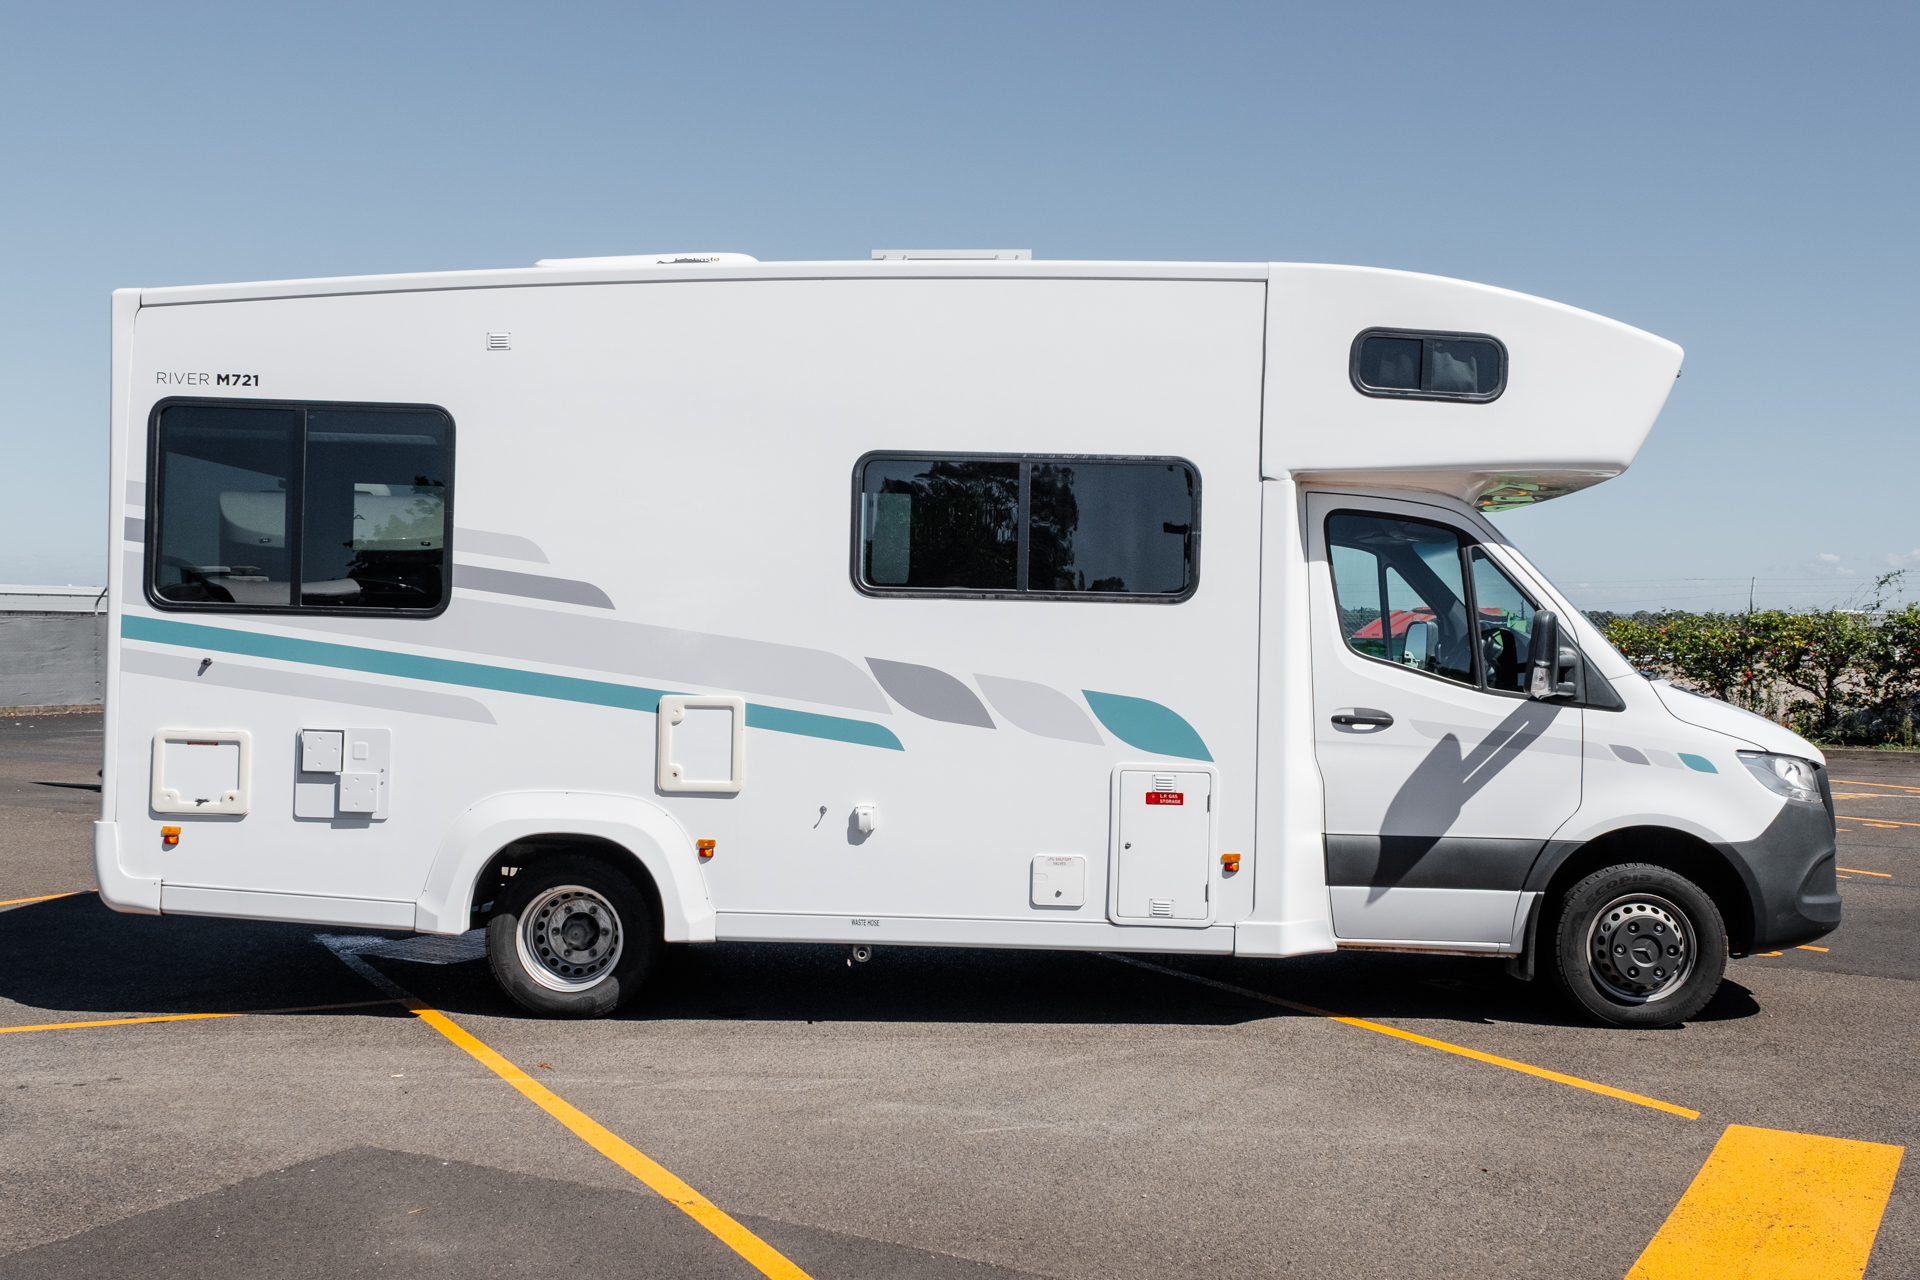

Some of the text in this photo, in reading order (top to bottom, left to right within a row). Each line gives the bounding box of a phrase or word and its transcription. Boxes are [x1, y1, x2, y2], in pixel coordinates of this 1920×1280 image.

[674, 256, 720, 264] basto
[156, 371, 259, 386] RIVER M721
[867, 919, 880, 927] HOSE
